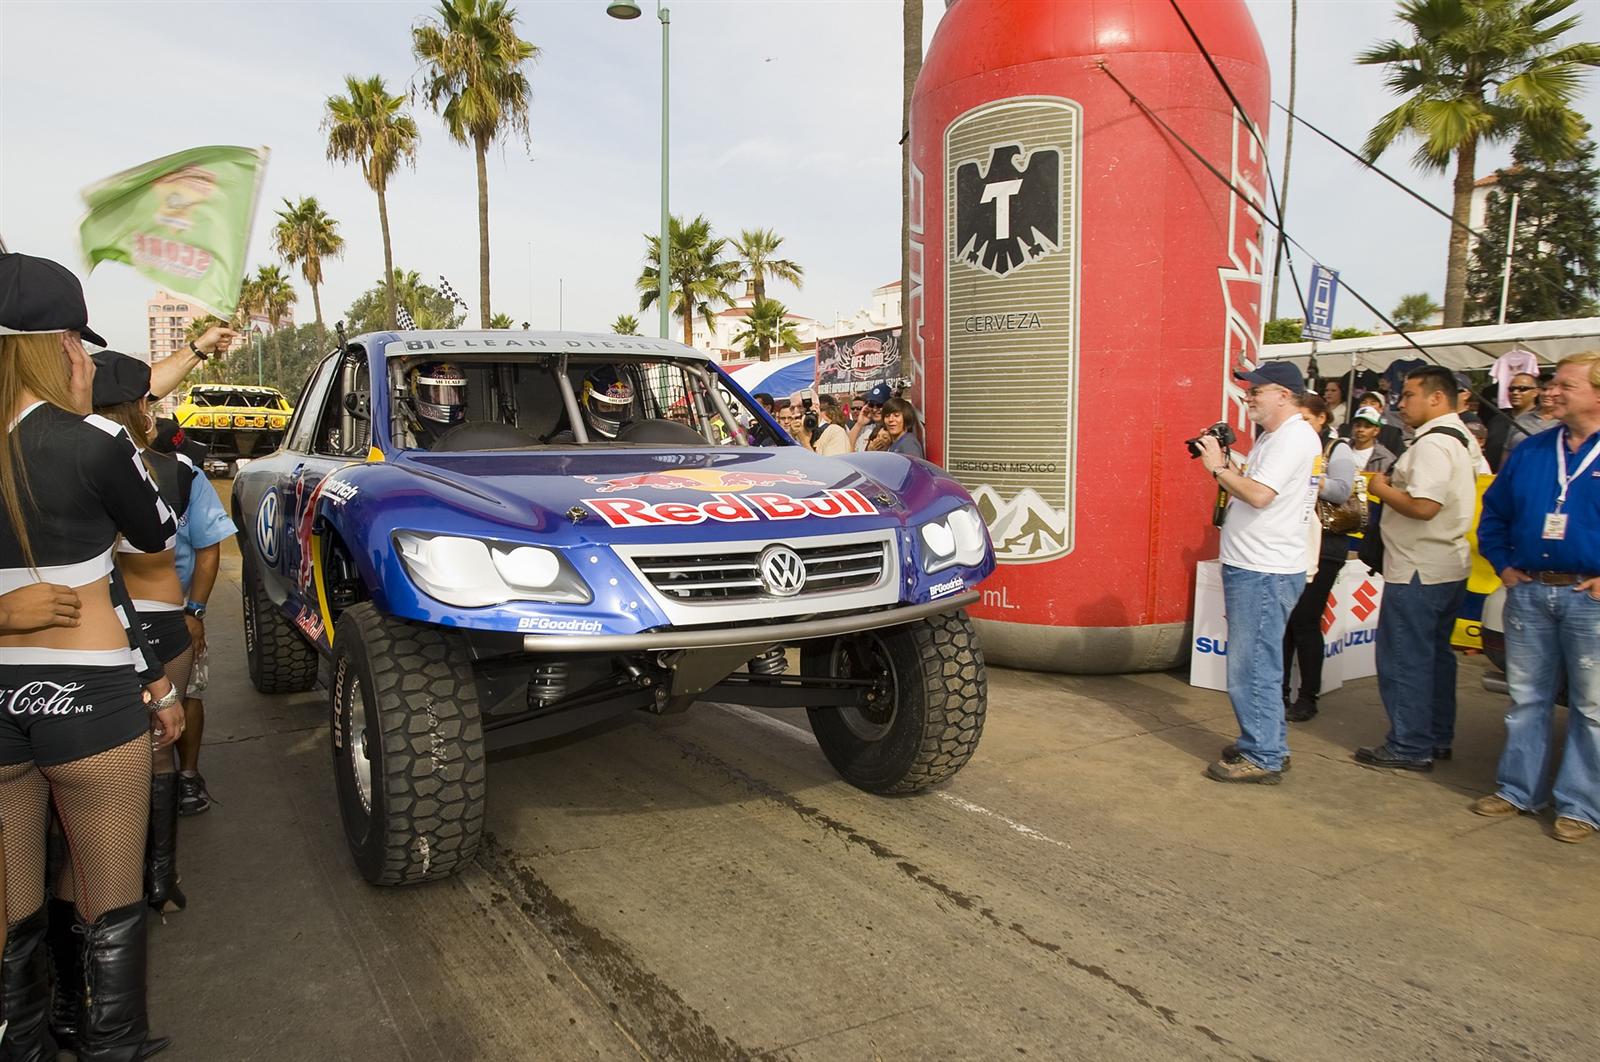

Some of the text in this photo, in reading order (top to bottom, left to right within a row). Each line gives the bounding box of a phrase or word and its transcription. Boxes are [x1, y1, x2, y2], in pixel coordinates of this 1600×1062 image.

[980, 179, 1023, 239] T
[964, 313, 1041, 332] CERVEZA
[440, 339, 668, 351] CLEAN DIESEL
[956, 462, 1057, 473] HECHO EN MEXICO
[583, 489, 879, 528] Red Bull
[930, 577, 964, 596] BFGoodrich
[983, 586, 1020, 609] mL.
[518, 617, 602, 631] BFGoodrich
[75, 704, 93, 714] MR
